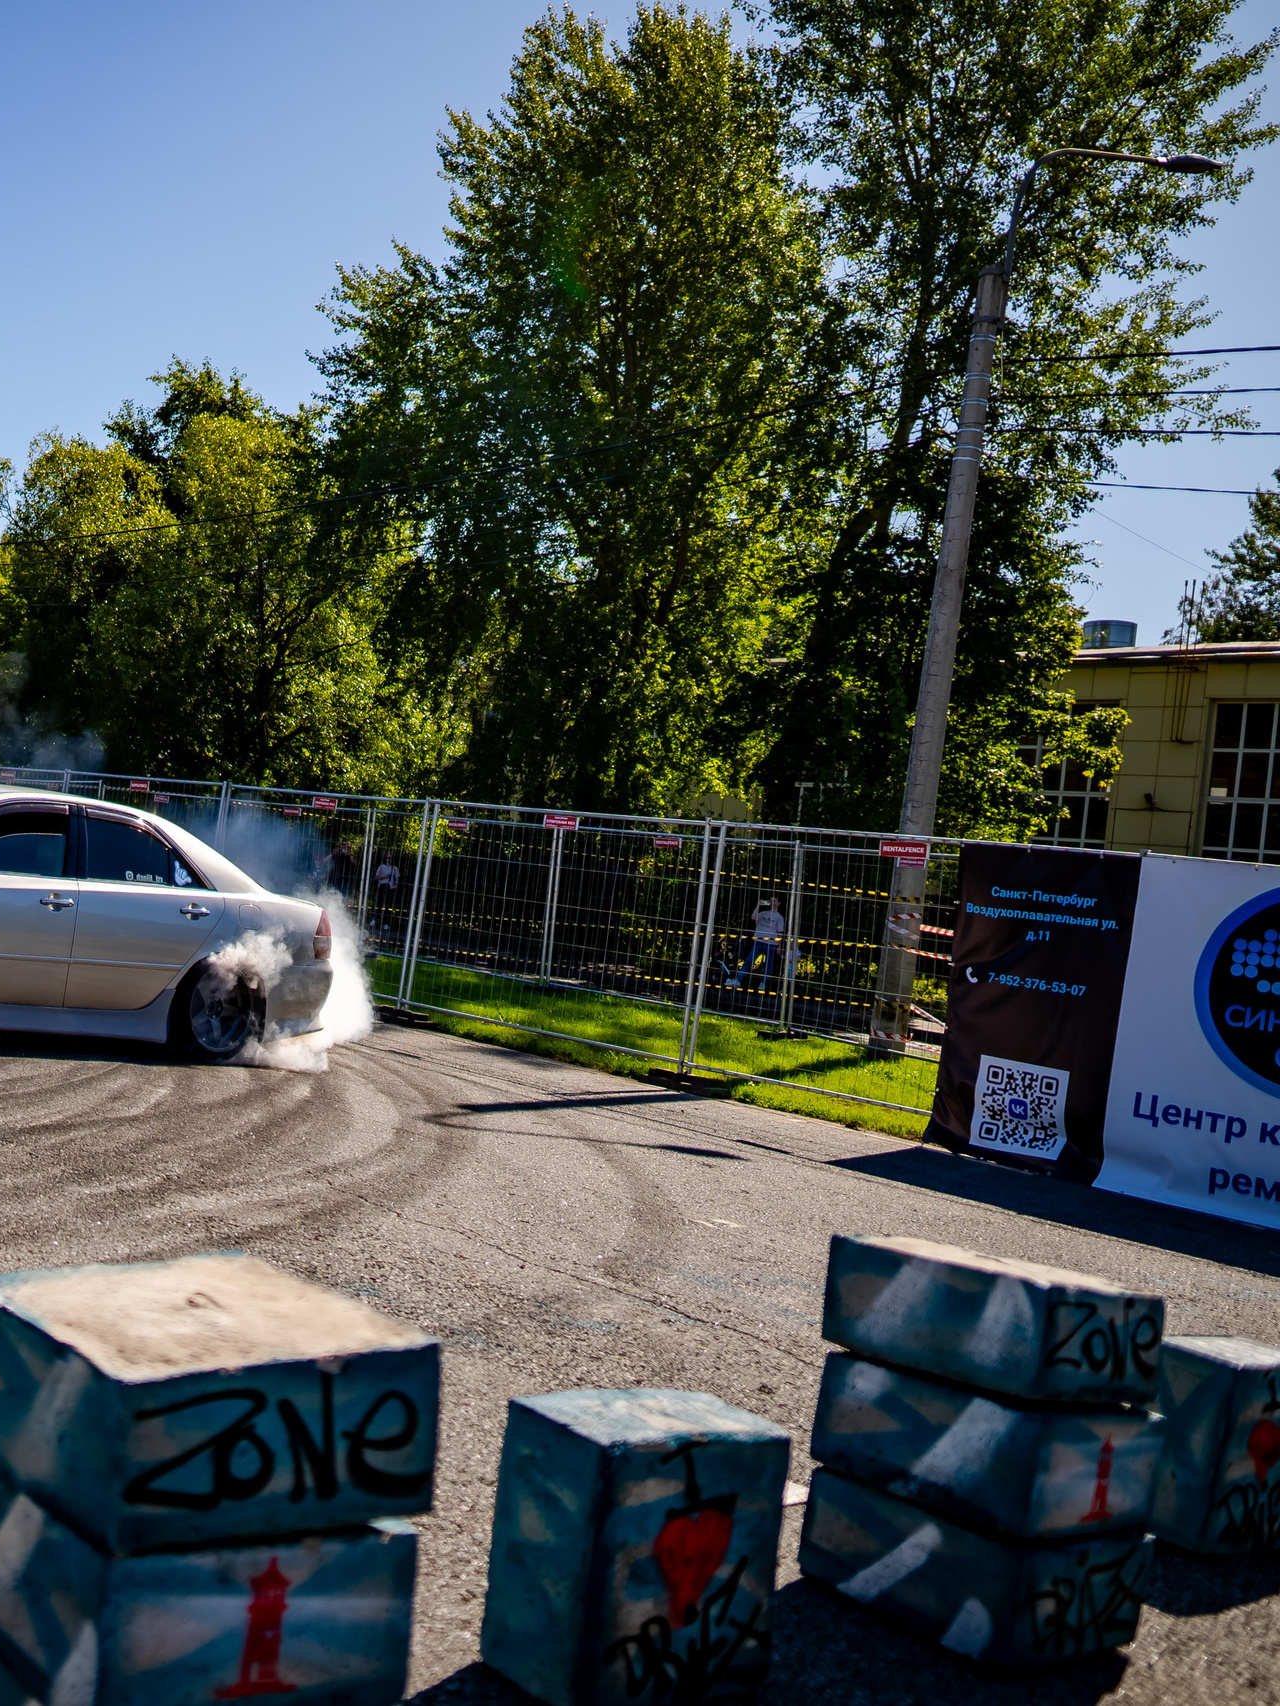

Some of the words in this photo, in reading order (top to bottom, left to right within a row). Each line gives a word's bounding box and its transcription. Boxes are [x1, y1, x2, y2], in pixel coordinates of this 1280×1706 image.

[882, 845, 925, 854] RENTALFENCE
[991, 886, 1098, 909] Санкт-Петербург
[966, 902, 1099, 927] Воздухоплавательная
[1101, 919, 1119, 931] ул.
[1025, 930, 1051, 942] д.11
[988, 972, 1087, 997] 7-952-376-53-07
[1132, 1091, 1248, 1144] Центр
[1208, 1166, 1280, 1203] рем
